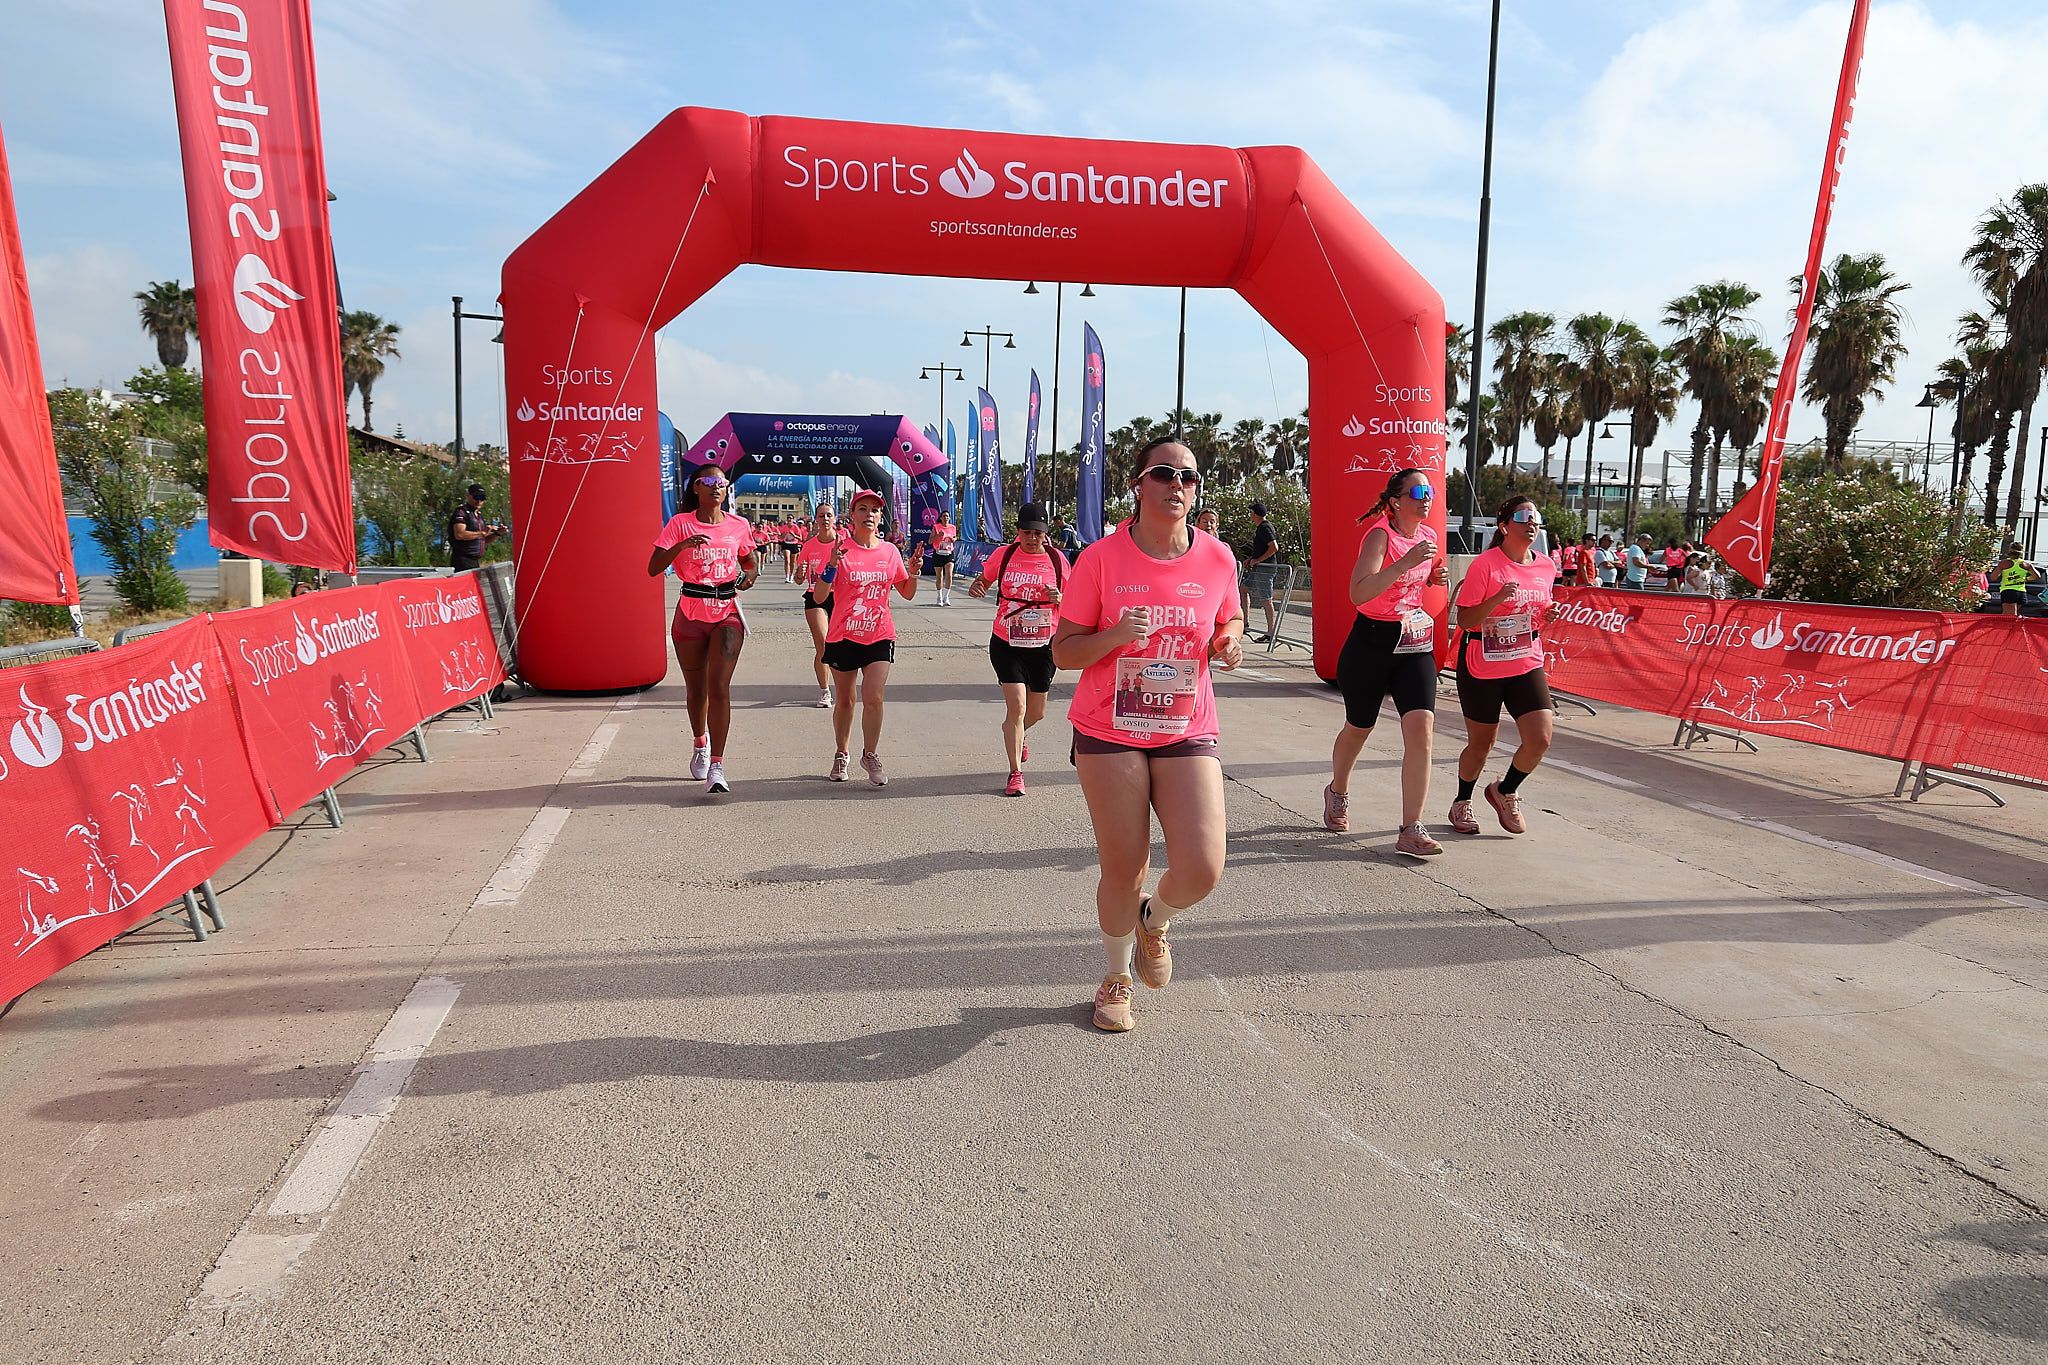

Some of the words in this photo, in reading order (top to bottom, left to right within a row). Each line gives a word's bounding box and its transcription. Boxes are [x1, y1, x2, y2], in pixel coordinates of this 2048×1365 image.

[783, 145, 929, 200] Sports
[1003, 160, 1229, 208] Santander
[930, 217, 1077, 240] sportssantander.es
[542, 364, 614, 390] Sports
[1375, 384, 1432, 406] Sports
[538, 402, 644, 421] Santander
[787, 422, 826, 432] octopus
[827, 424, 859, 434] energy
[780, 434, 811, 442] ENERGÍA
[751, 454, 841, 465] VOLVO
[692, 547, 732, 560] CARRERA
[714, 563, 728, 579] DE
[849, 571, 888, 582] CARRERA
[1004, 571, 1043, 585] CARRERA
[867, 585, 881, 600] DE
[1115, 584, 1150, 594] OYSHO
[399, 595, 440, 637] Sports
[846, 616, 877, 632] MUJER
[1119, 605, 1198, 628] CRRERA
[1550, 600, 1635, 634] antander
[1412, 629, 1426, 639] 016
[1498, 635, 1517, 644] 016
[1676, 614, 1751, 650] Sports
[1784, 622, 1956, 664] Santander
[240, 635, 298, 696] Sports
[311, 608, 380, 658] Santander
[66, 660, 208, 752] Santander
[1142, 693, 1174, 706] 016
[1122, 720, 1150, 728] OYSHO
